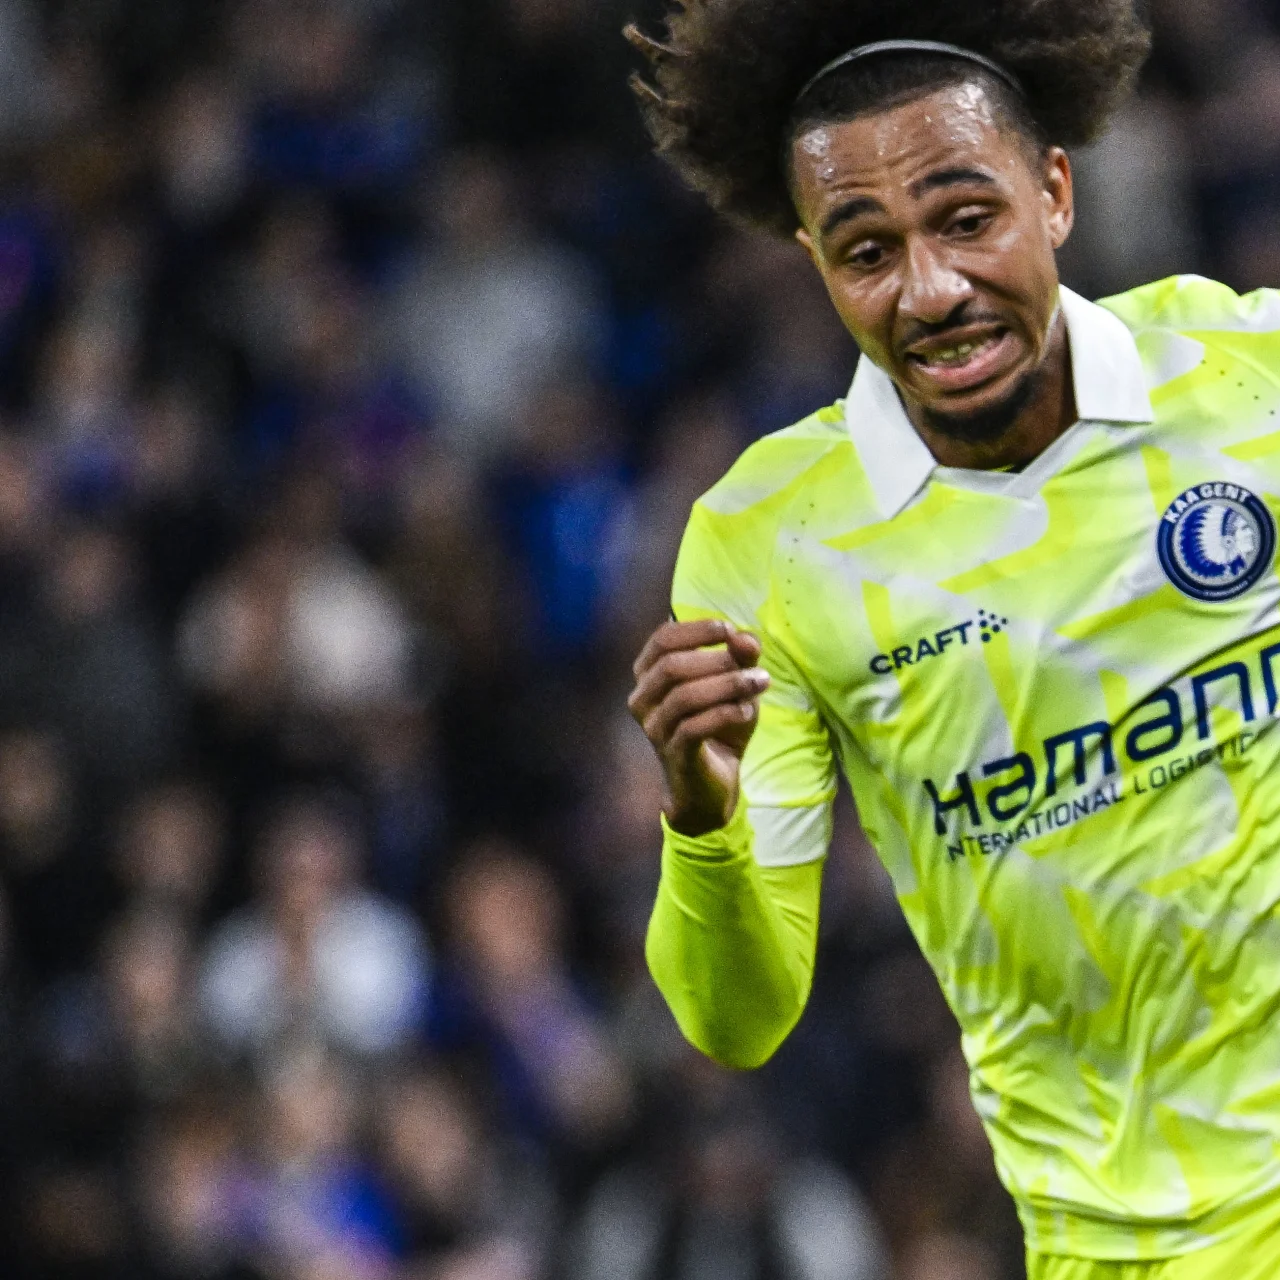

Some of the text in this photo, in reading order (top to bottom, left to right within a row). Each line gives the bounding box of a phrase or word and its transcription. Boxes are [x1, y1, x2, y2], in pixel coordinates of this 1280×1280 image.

[1164, 483, 1252, 523] KAA GENT
[869, 620, 973, 675] CRAFT
[946, 782, 1125, 861] NTERNATIONAL
